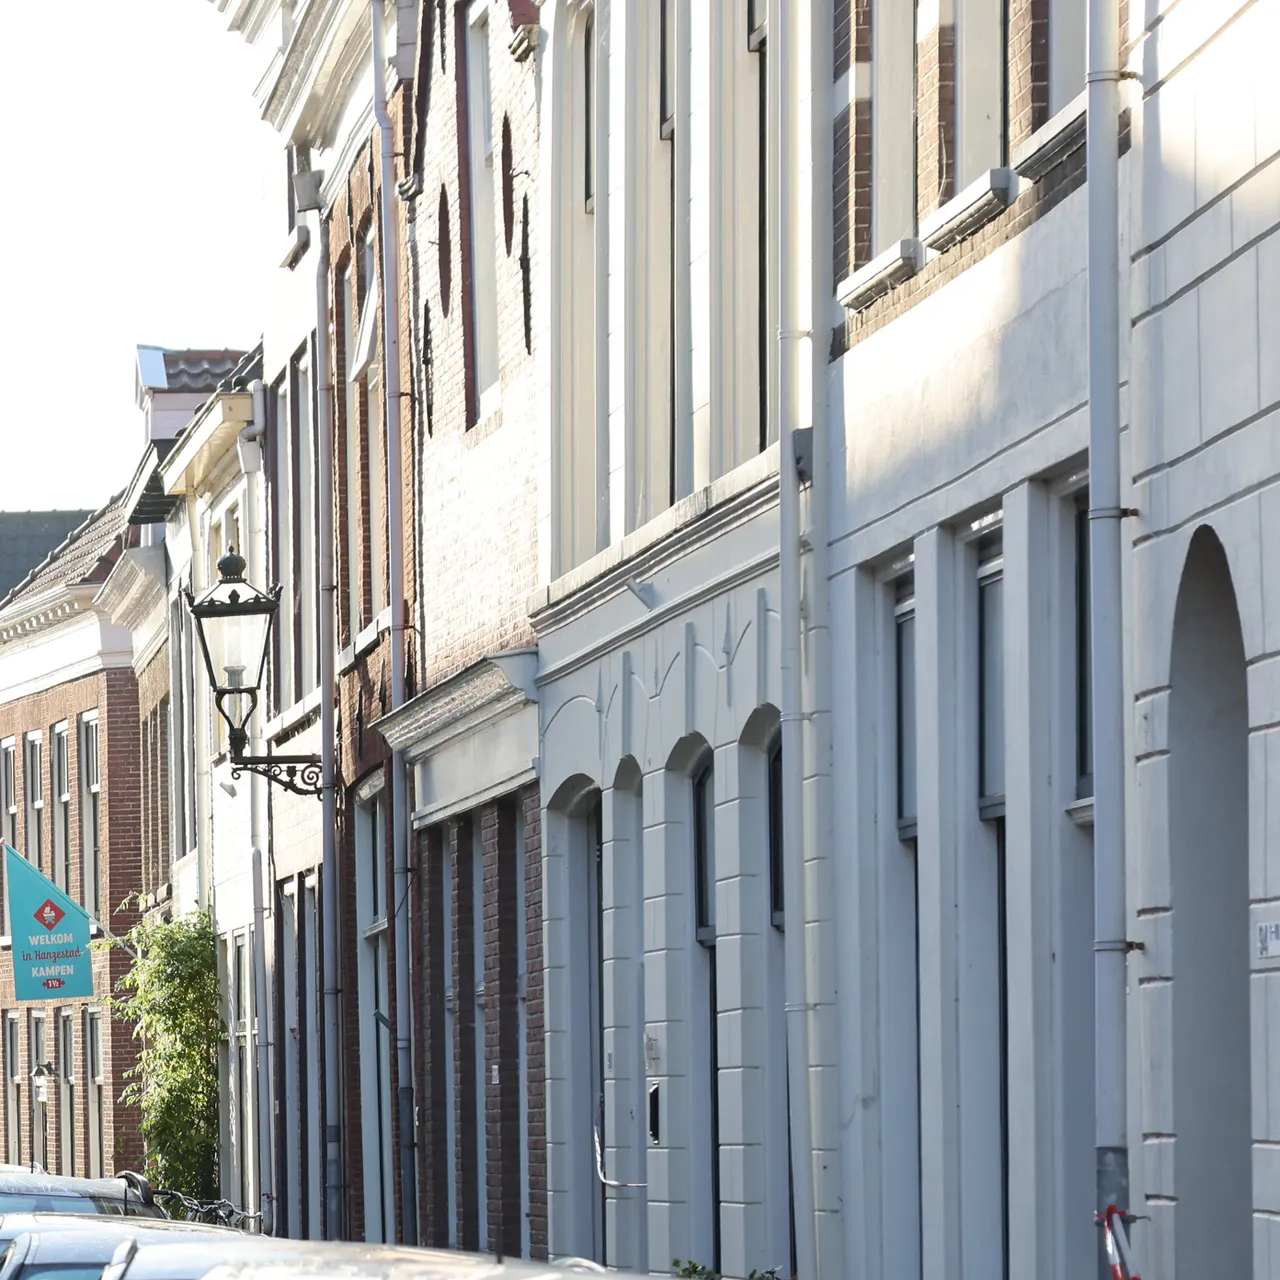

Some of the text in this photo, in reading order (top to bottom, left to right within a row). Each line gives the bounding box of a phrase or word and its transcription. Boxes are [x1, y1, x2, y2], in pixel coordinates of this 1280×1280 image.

[28, 933, 74, 946] WELKOM
[22, 945, 82, 964] in Hanzestad
[31, 965, 74, 978] KAMPEN
